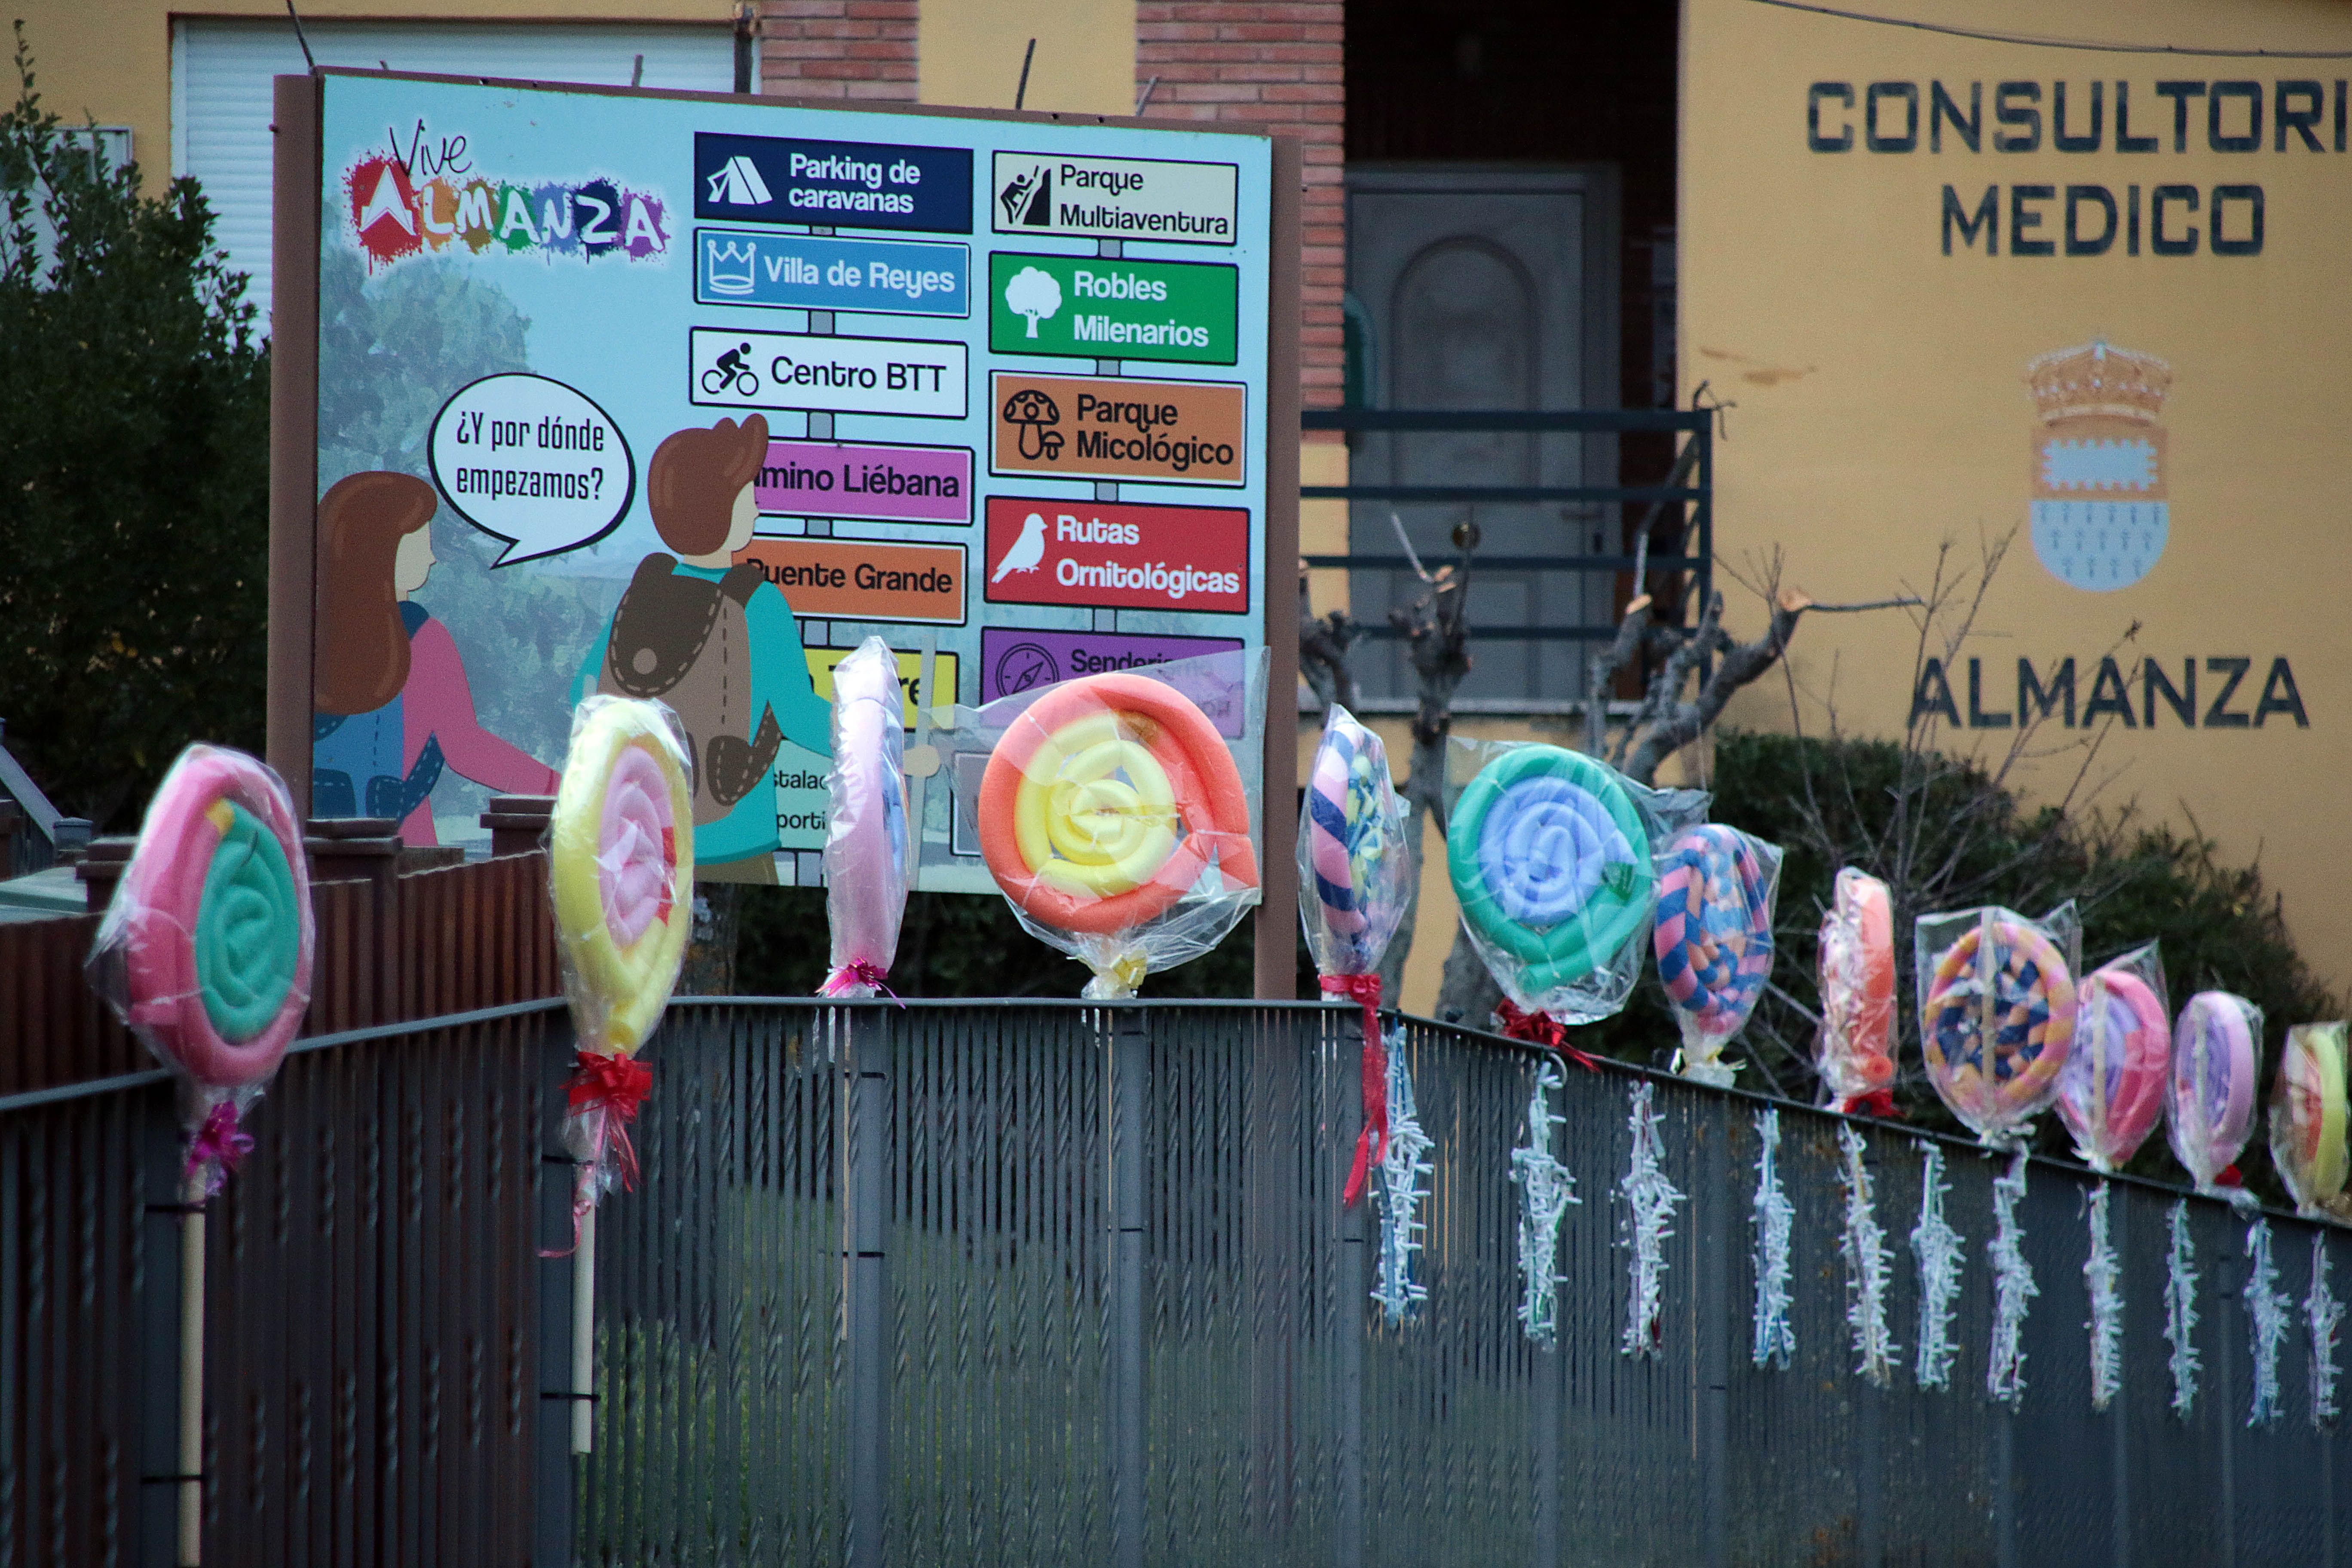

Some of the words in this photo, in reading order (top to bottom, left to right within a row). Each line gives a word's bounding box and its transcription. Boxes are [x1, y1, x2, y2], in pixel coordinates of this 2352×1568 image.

[1807, 80, 2349, 153] CONSULTORI
[389, 118, 473, 178] Vive
[790, 153, 883, 189] Parking
[888, 159, 921, 184] de
[1060, 164, 1144, 196] Parque
[359, 165, 666, 251] ALMANZA
[788, 187, 915, 214] caravanas
[1060, 203, 1228, 235] Multiaventura
[1941, 184, 2266, 257] MEDICO
[764, 255, 819, 285] Villa
[827, 260, 862, 288] de
[869, 262, 956, 299] Reyes
[1075, 271, 1167, 301] Robles
[1075, 315, 1209, 348] Milenarios
[772, 355, 877, 389] Centro
[887, 363, 947, 392] BTT
[456, 411, 484, 444] ¿Y
[491, 420, 530, 452] por
[537, 415, 604, 452] dónde
[1077, 393, 1178, 433] Parque
[1077, 430, 1234, 472] Micológico
[456, 467, 604, 501] empezamos?
[754, 461, 834, 491] mino
[843, 464, 959, 498] Liébana
[1057, 514, 1140, 545] Rutas
[854, 564, 953, 593] Grande
[1056, 558, 1240, 599] Ornitológicas
[1906, 656, 2310, 729] ALMANZA
